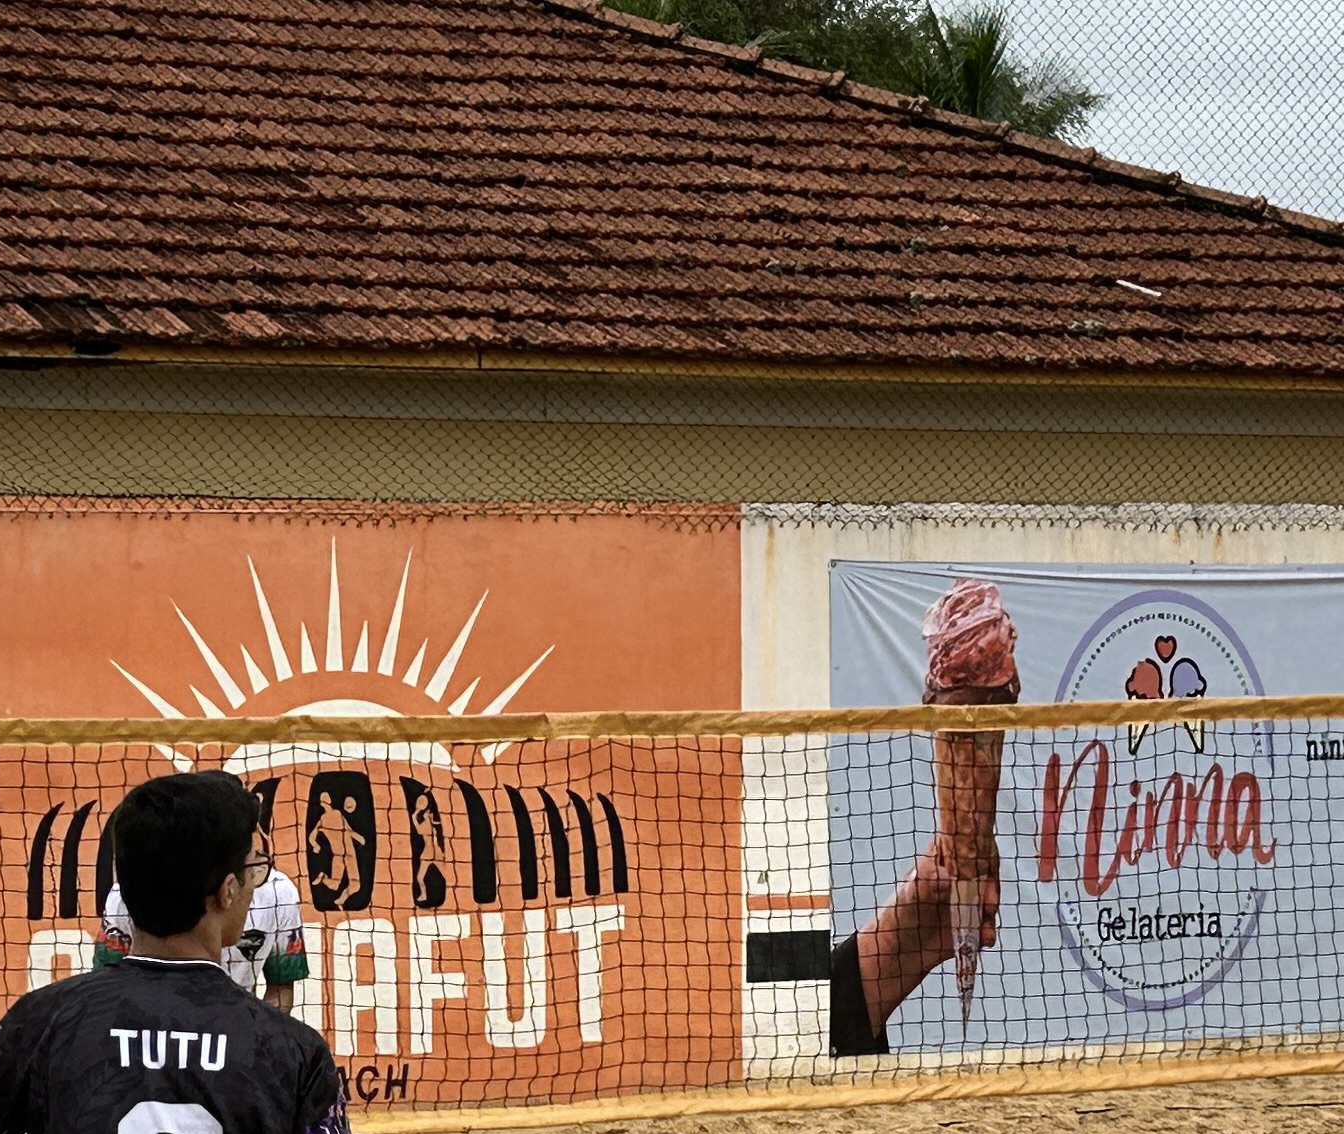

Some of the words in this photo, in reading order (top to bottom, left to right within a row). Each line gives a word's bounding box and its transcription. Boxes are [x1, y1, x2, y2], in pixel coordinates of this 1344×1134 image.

[1038, 739, 1278, 896] Ninna
[1097, 902, 1222, 941] Gelateria
[109, 1028, 228, 1071] TUTU
